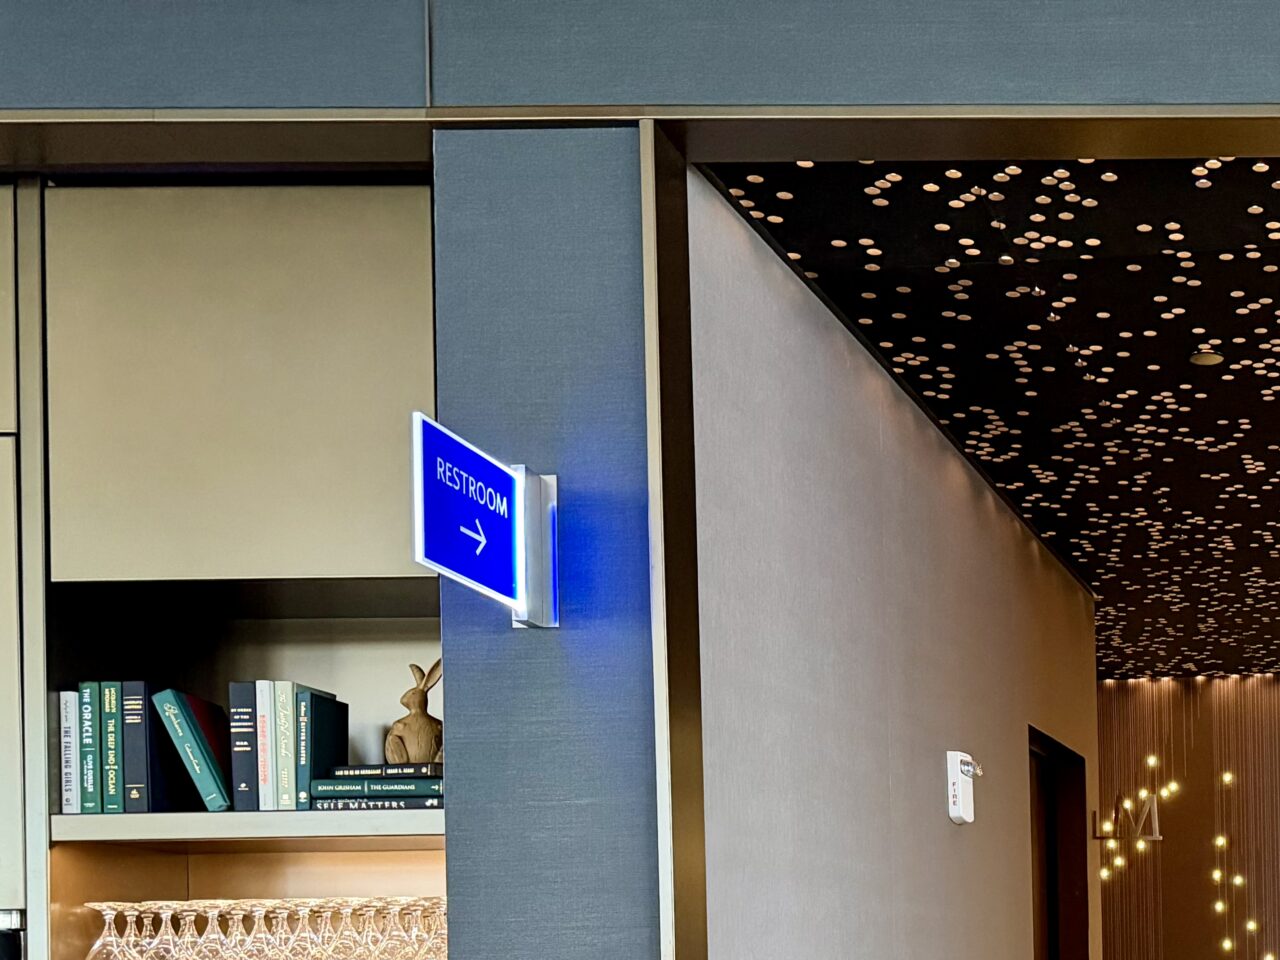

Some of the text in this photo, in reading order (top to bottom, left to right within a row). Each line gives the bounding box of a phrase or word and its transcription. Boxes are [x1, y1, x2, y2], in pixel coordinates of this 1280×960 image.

[436, 456, 508, 518] RESTROOM
[82, 688, 93, 744] THE ORACLE
[107, 719, 115, 732] THE
[63, 726, 71, 738] THE
[107, 733, 115, 749] DEEP
[63, 741, 72, 769] FALLING
[64, 772, 72, 793] GIRLS
[107, 770, 115, 795] OCEAN
[349, 801, 405, 809] MATTERS
